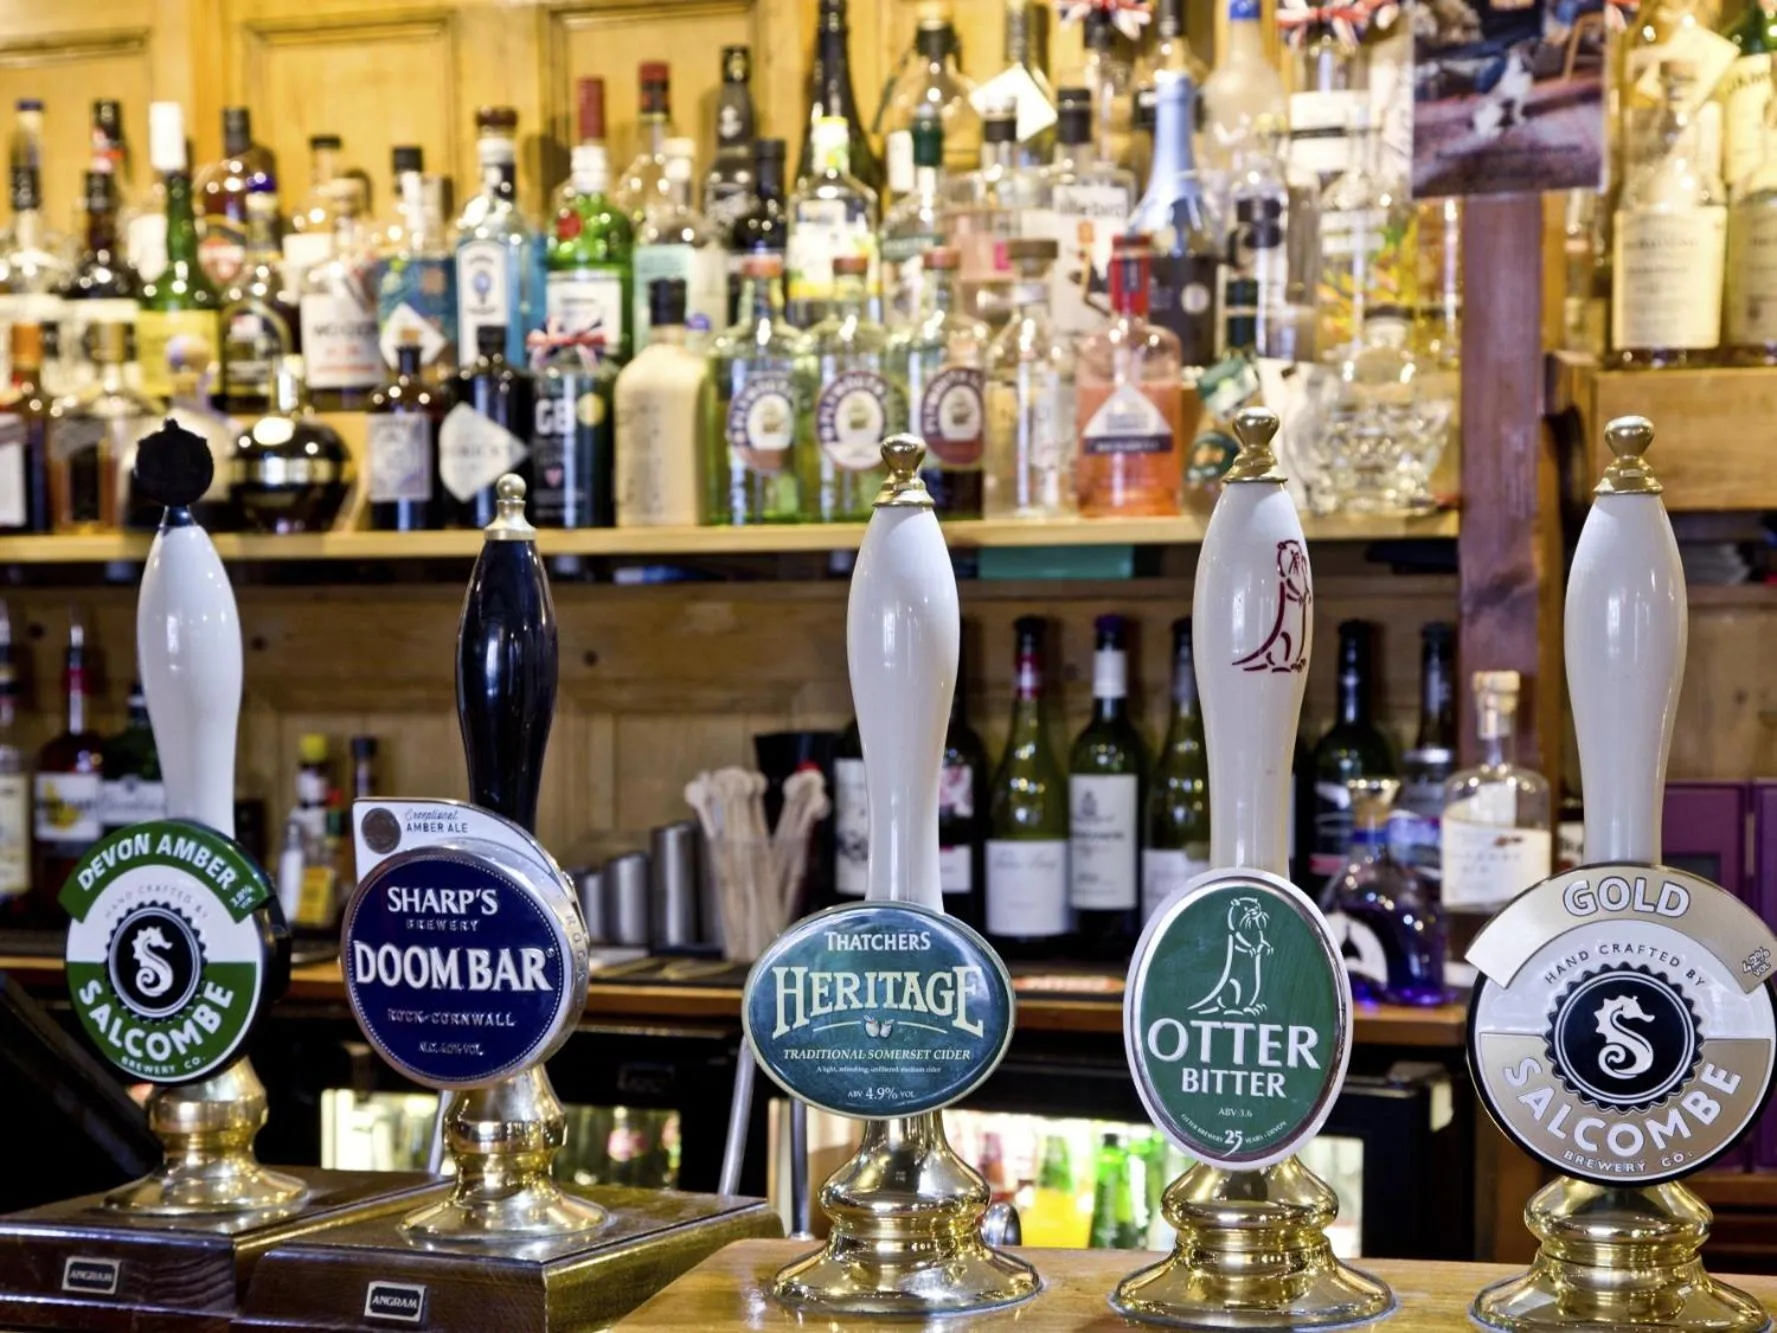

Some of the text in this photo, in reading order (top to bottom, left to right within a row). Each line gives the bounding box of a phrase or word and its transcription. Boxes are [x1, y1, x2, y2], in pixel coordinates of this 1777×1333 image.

[406, 822, 469, 834] AMBER ALE
[77, 833, 239, 891] DEVON AMBER
[387, 886, 499, 916] SHARP'S
[1562, 876, 1691, 918] GOLD
[406, 918, 481, 932] BREWERY
[823, 931, 932, 951] THATCHERS
[353, 940, 554, 992] DOOM BAR
[1544, 943, 1706, 987] HAND CRAFTED BY
[771, 966, 985, 1040] HERITAGE
[78, 979, 235, 1061] SALCOMBE
[783, 1049, 971, 1061] TRADITIONAL SOMERSET CIDER
[1147, 1018, 1321, 1069] OTTER
[120, 1056, 176, 1076] BREWERY
[847, 1090, 862, 1098] ABV
[865, 1087, 898, 1100] 4.9%
[1181, 1067, 1287, 1098] BITTER
[1503, 1057, 1742, 1158] SALCOMBE
[1224, 1129, 1243, 1158] 25
[1563, 1150, 1647, 1172] BREWERY
[371, 1294, 418, 1310] ANGRAM
